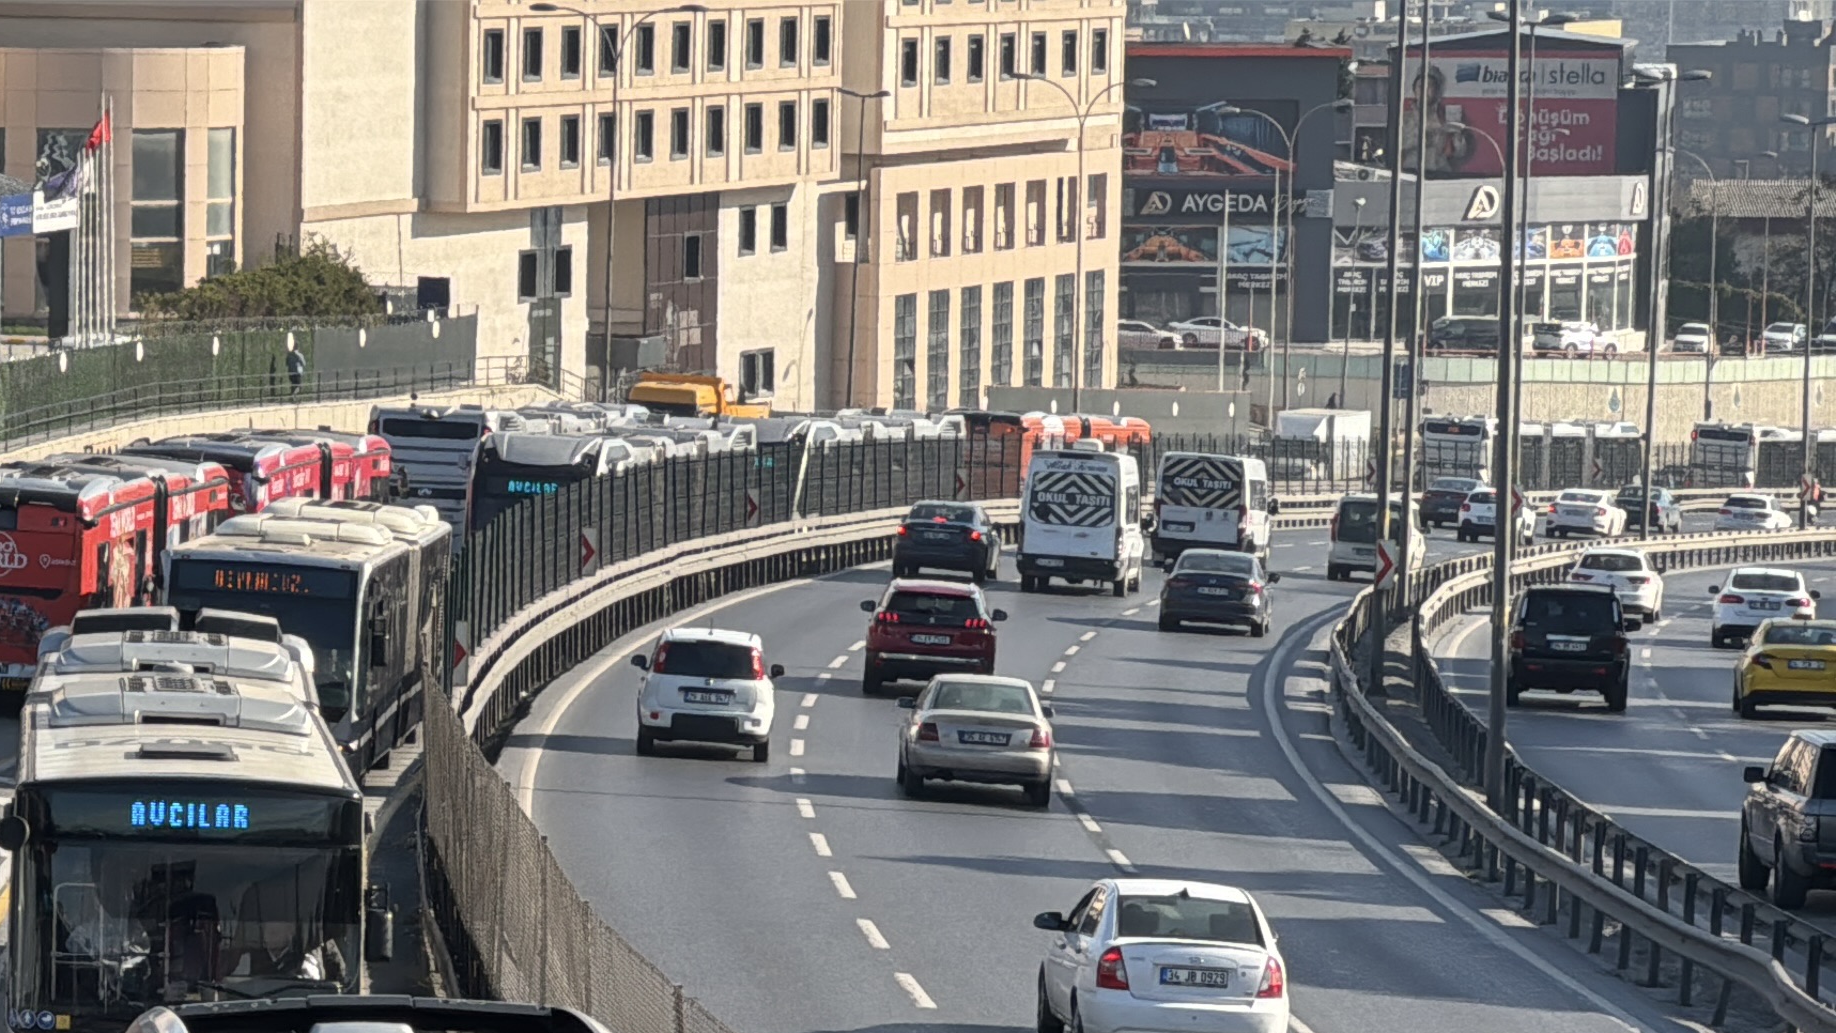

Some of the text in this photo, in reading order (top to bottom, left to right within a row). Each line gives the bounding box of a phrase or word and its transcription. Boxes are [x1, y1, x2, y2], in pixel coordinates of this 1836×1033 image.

[1549, 62, 1605, 85] stella
[1181, 193, 1268, 213] AYGEDA
[1424, 275, 1444, 287] VIP
[1173, 477, 1198, 488] OKUL
[1037, 491, 1069, 504] OKUL
[130, 800, 251, 829] AVCILAR
[1168, 971, 1180, 981] 34
[1200, 973, 1226, 984] 0929
